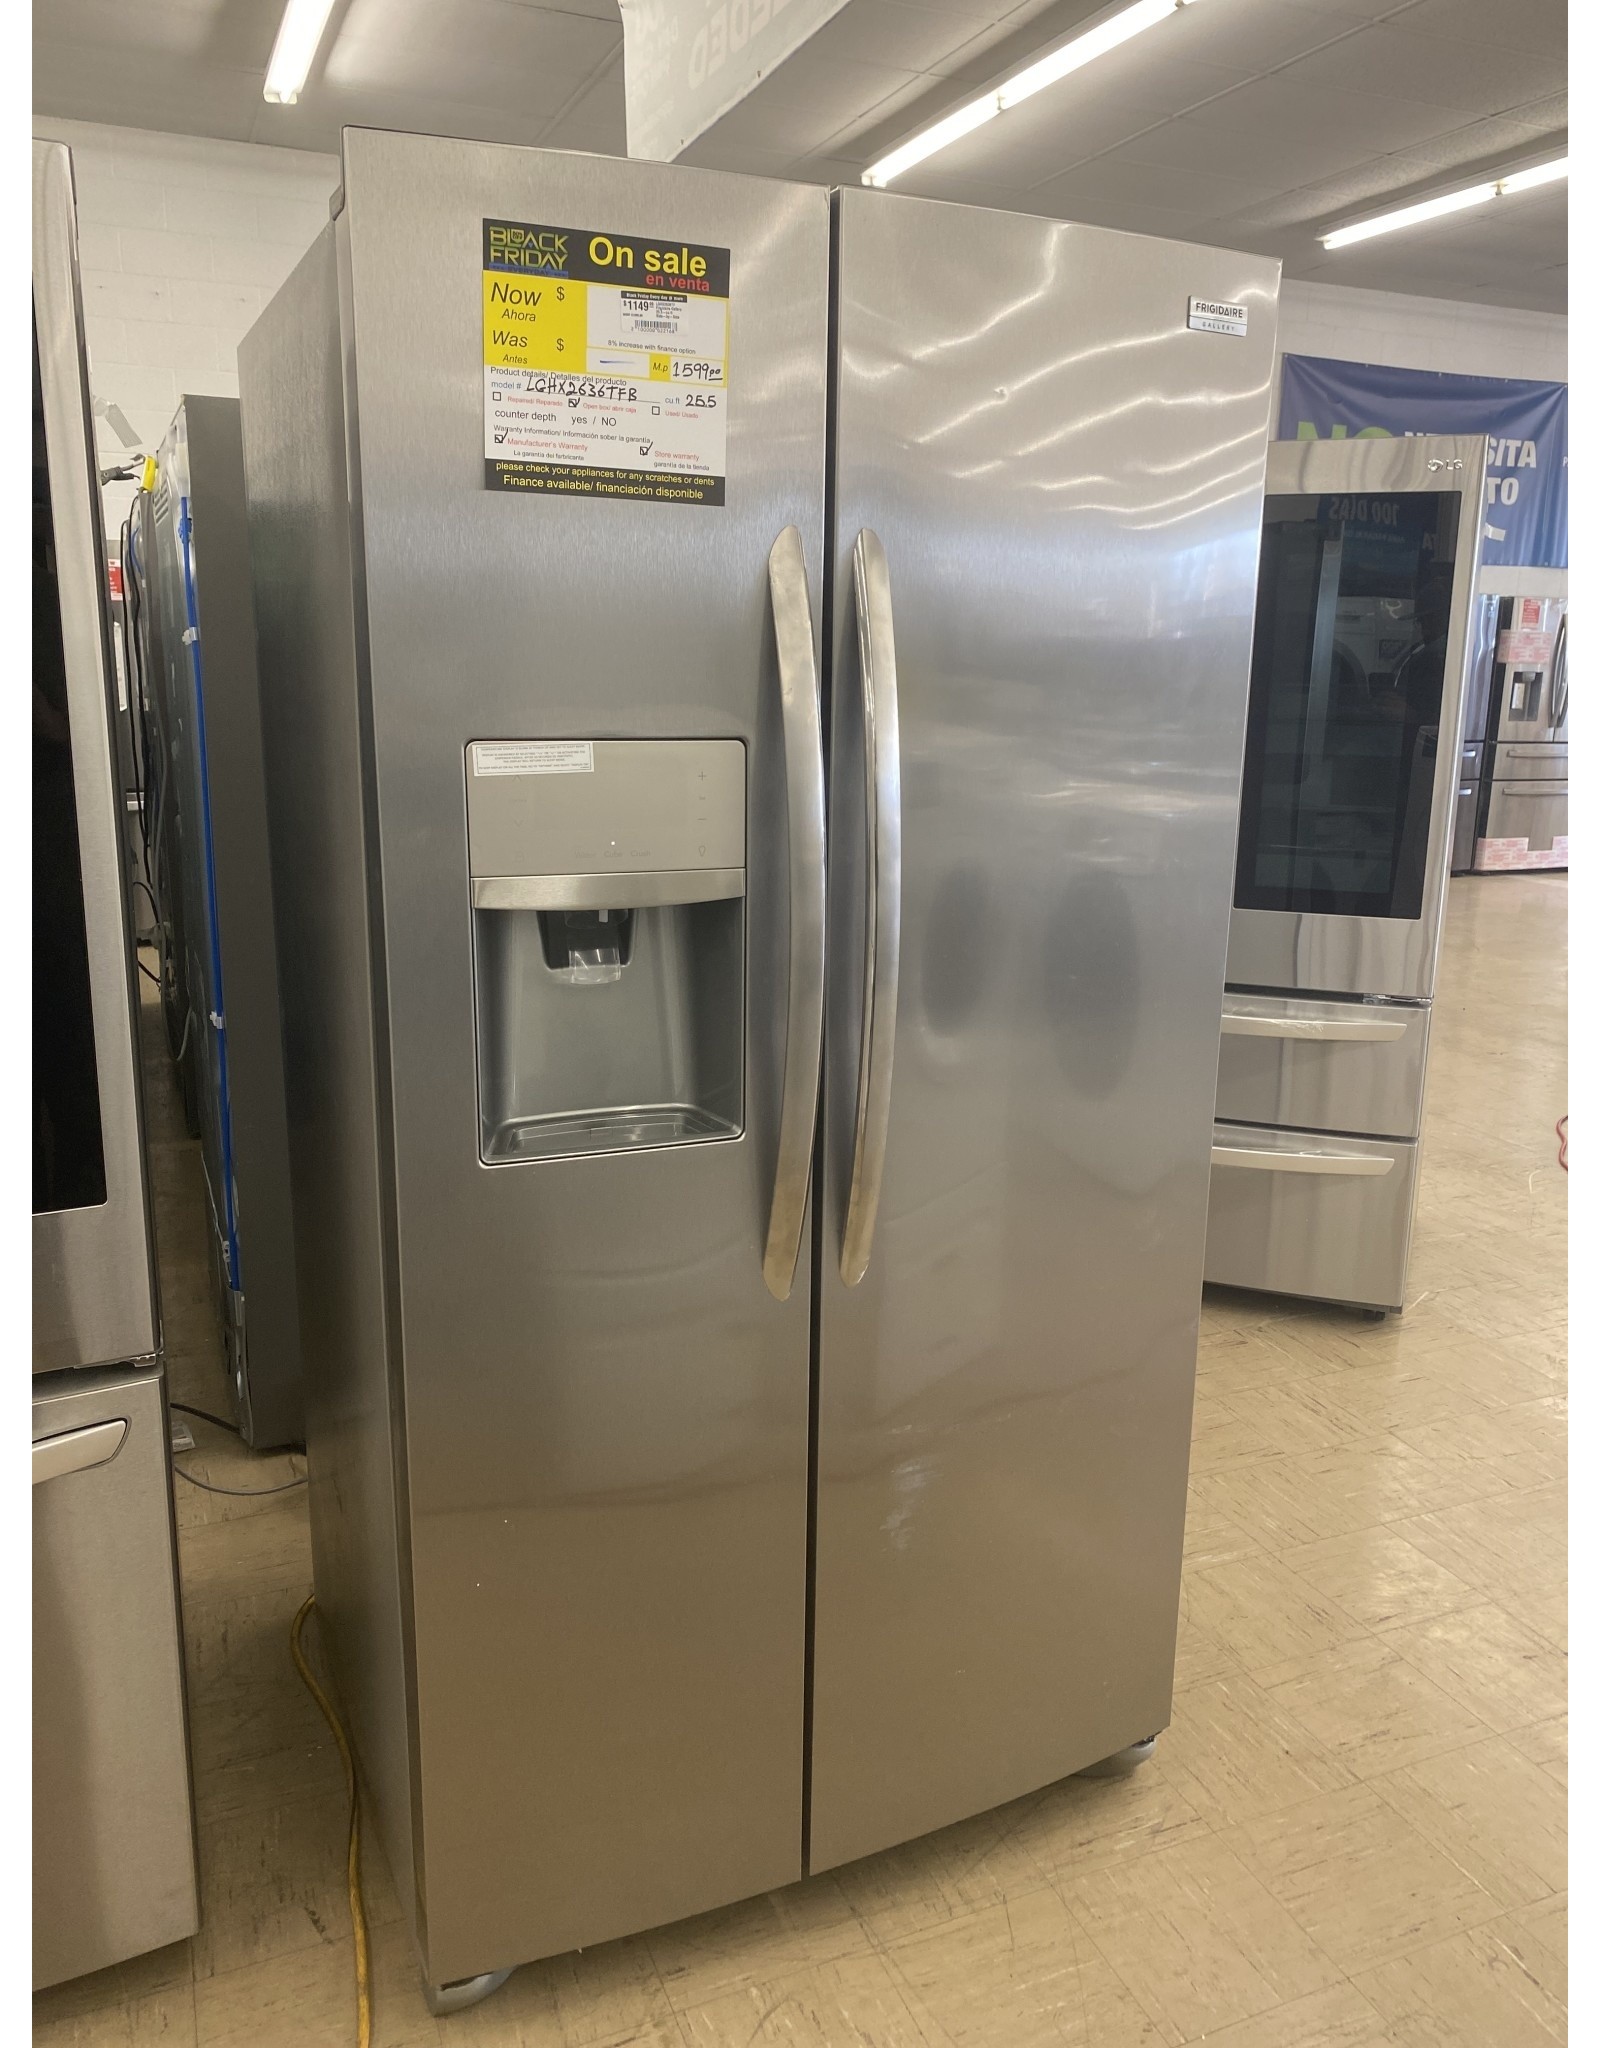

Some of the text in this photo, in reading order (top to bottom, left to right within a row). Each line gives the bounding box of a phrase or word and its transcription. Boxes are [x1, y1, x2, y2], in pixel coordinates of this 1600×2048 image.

[489, 226, 569, 254] BLACK
[490, 245, 569, 271] FRIDAY
[589, 236, 707, 277] On sale
[645, 274, 710, 292] en venta
[490, 282, 565, 307] Now $
[501, 308, 537, 322] Ahora
[1195, 302, 1243, 318] FRIGIDAIRE
[1202, 321, 1235, 331] GALLERY
[492, 329, 565, 353] Was $
[607, 339, 618, 347] 8%
[618, 341, 643, 350] increase
[657, 345, 678, 353] finance
[678, 347, 697, 355] option
[502, 354, 528, 365] Antes
[490, 366, 520, 377] Product
[550, 371, 580, 382] Detalles
[582, 375, 594, 384] del
[595, 376, 627, 387] producto
[491, 380, 515, 390] model
[583, 402, 598, 411] Open
[494, 409, 557, 423] counter depth
[571, 415, 588, 426] yes
[601, 417, 617, 427] NO
[493, 425, 523, 434] Warranty
[599, 433, 617, 441] sober
[618, 434, 625, 442] la
[507, 437, 589, 452] Manufacturer's Warranty
[654, 450, 700, 462] Store warranty
[692, 464, 710, 472] tienda
[1445, 459, 1463, 470] LG
[495, 461, 715, 486] please check your appliances for any scratches or dents
[503, 474, 704, 499] Finance available/ financiación disponible
